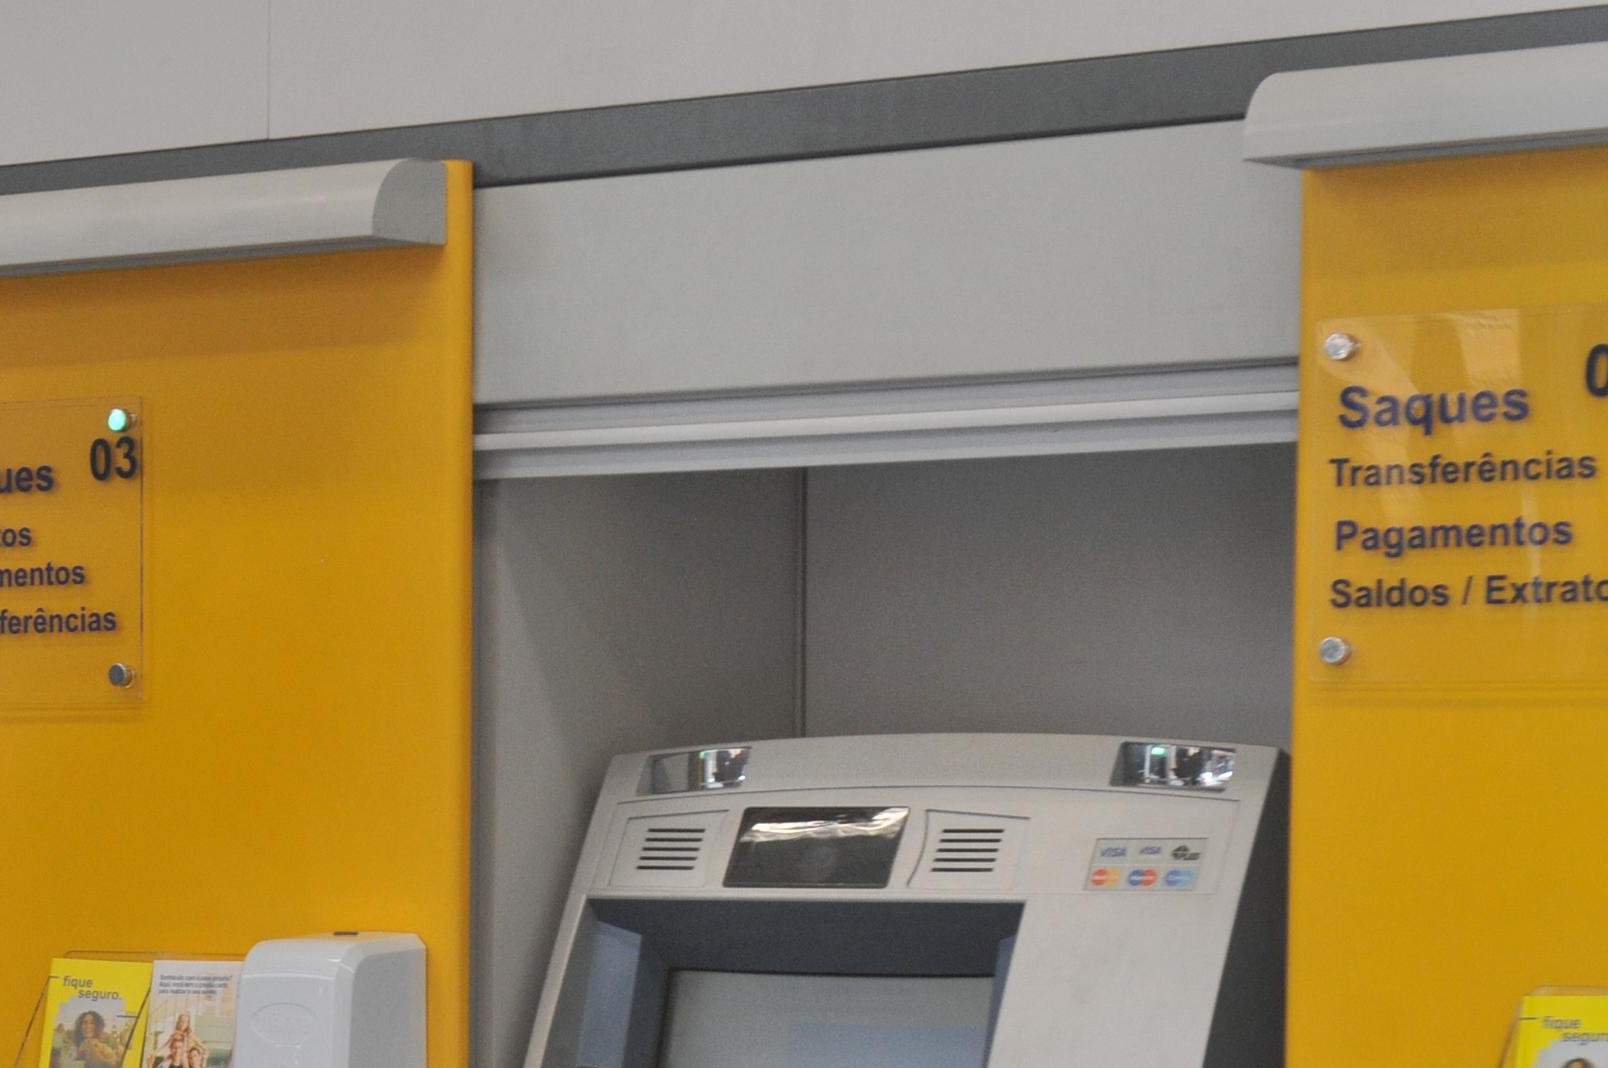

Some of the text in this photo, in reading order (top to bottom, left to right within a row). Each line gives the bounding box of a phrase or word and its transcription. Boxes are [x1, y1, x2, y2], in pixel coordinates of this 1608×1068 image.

[1338, 385, 1530, 435] Saques
[90, 436, 138, 481] 03
[1329, 451, 1597, 486] Transferências
[1335, 516, 1573, 558] Pagamentos
[1330, 578, 1450, 608] Saldos
[1100, 847, 1127, 857] VISA
[63, 976, 93, 989] fique
